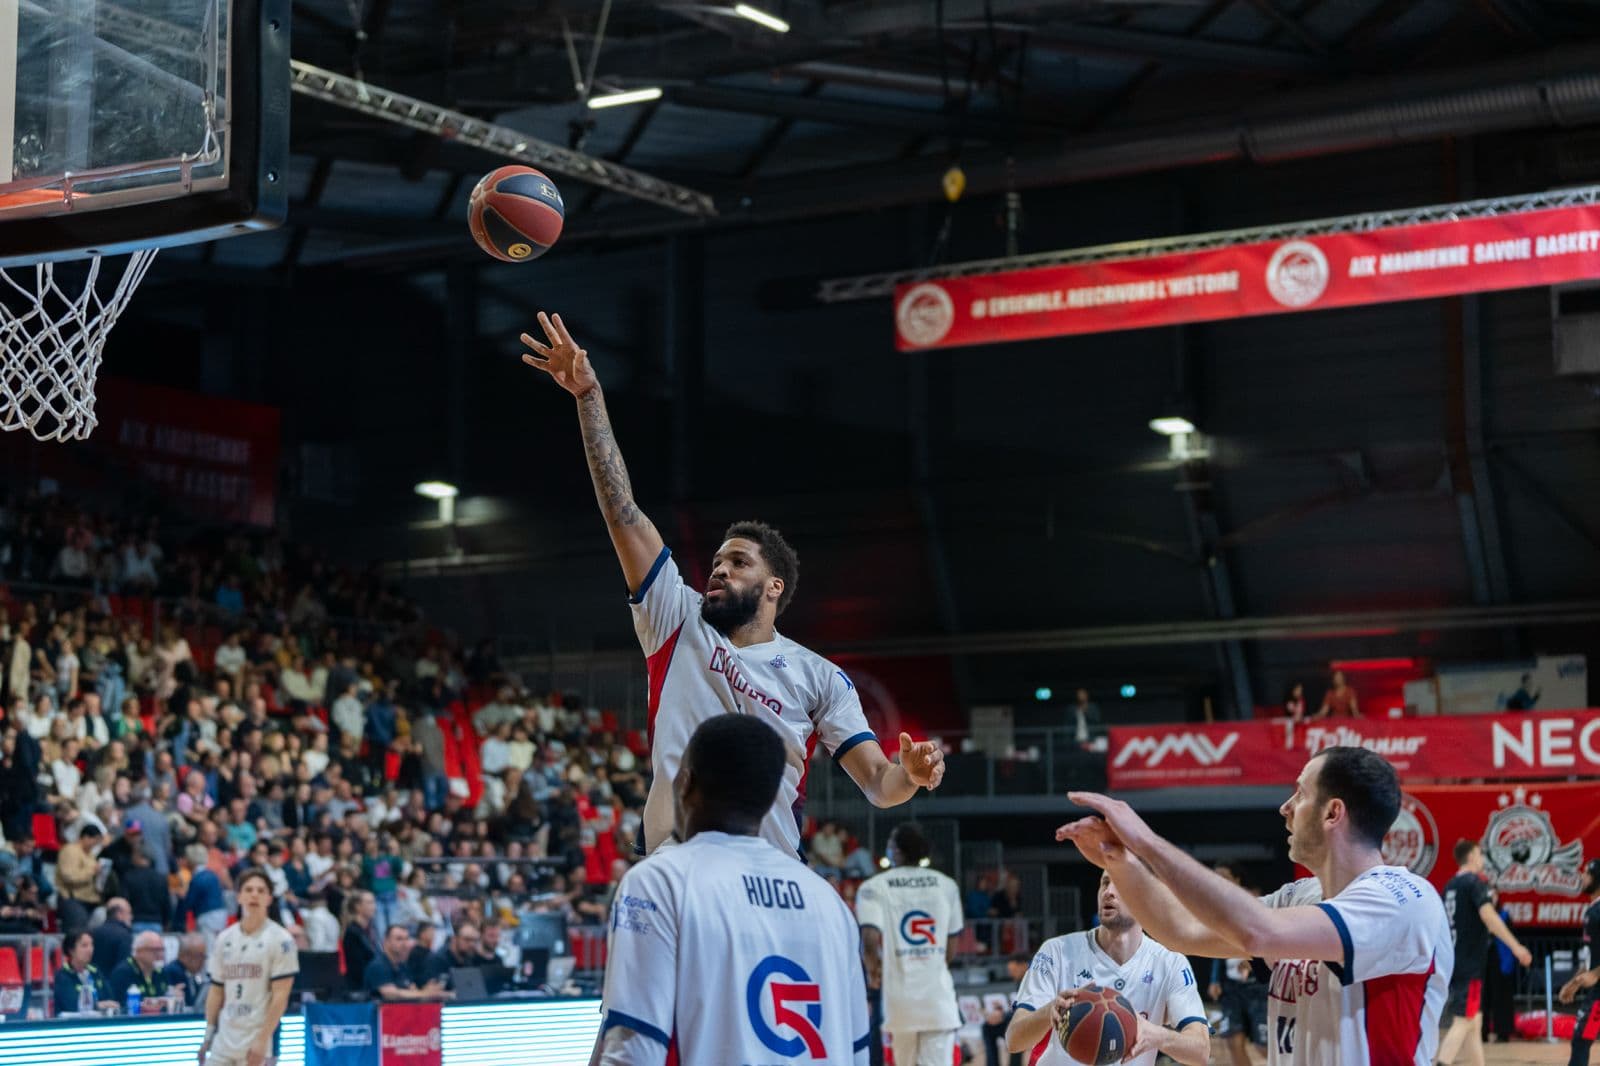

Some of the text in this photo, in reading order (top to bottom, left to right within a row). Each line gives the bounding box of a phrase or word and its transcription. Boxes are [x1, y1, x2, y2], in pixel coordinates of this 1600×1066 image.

[1348, 256, 1377, 278] AIX
[1474, 237, 1532, 264] SAVOIE
[1535, 230, 1600, 258] BASKET
[743, 875, 805, 910] HUGO
